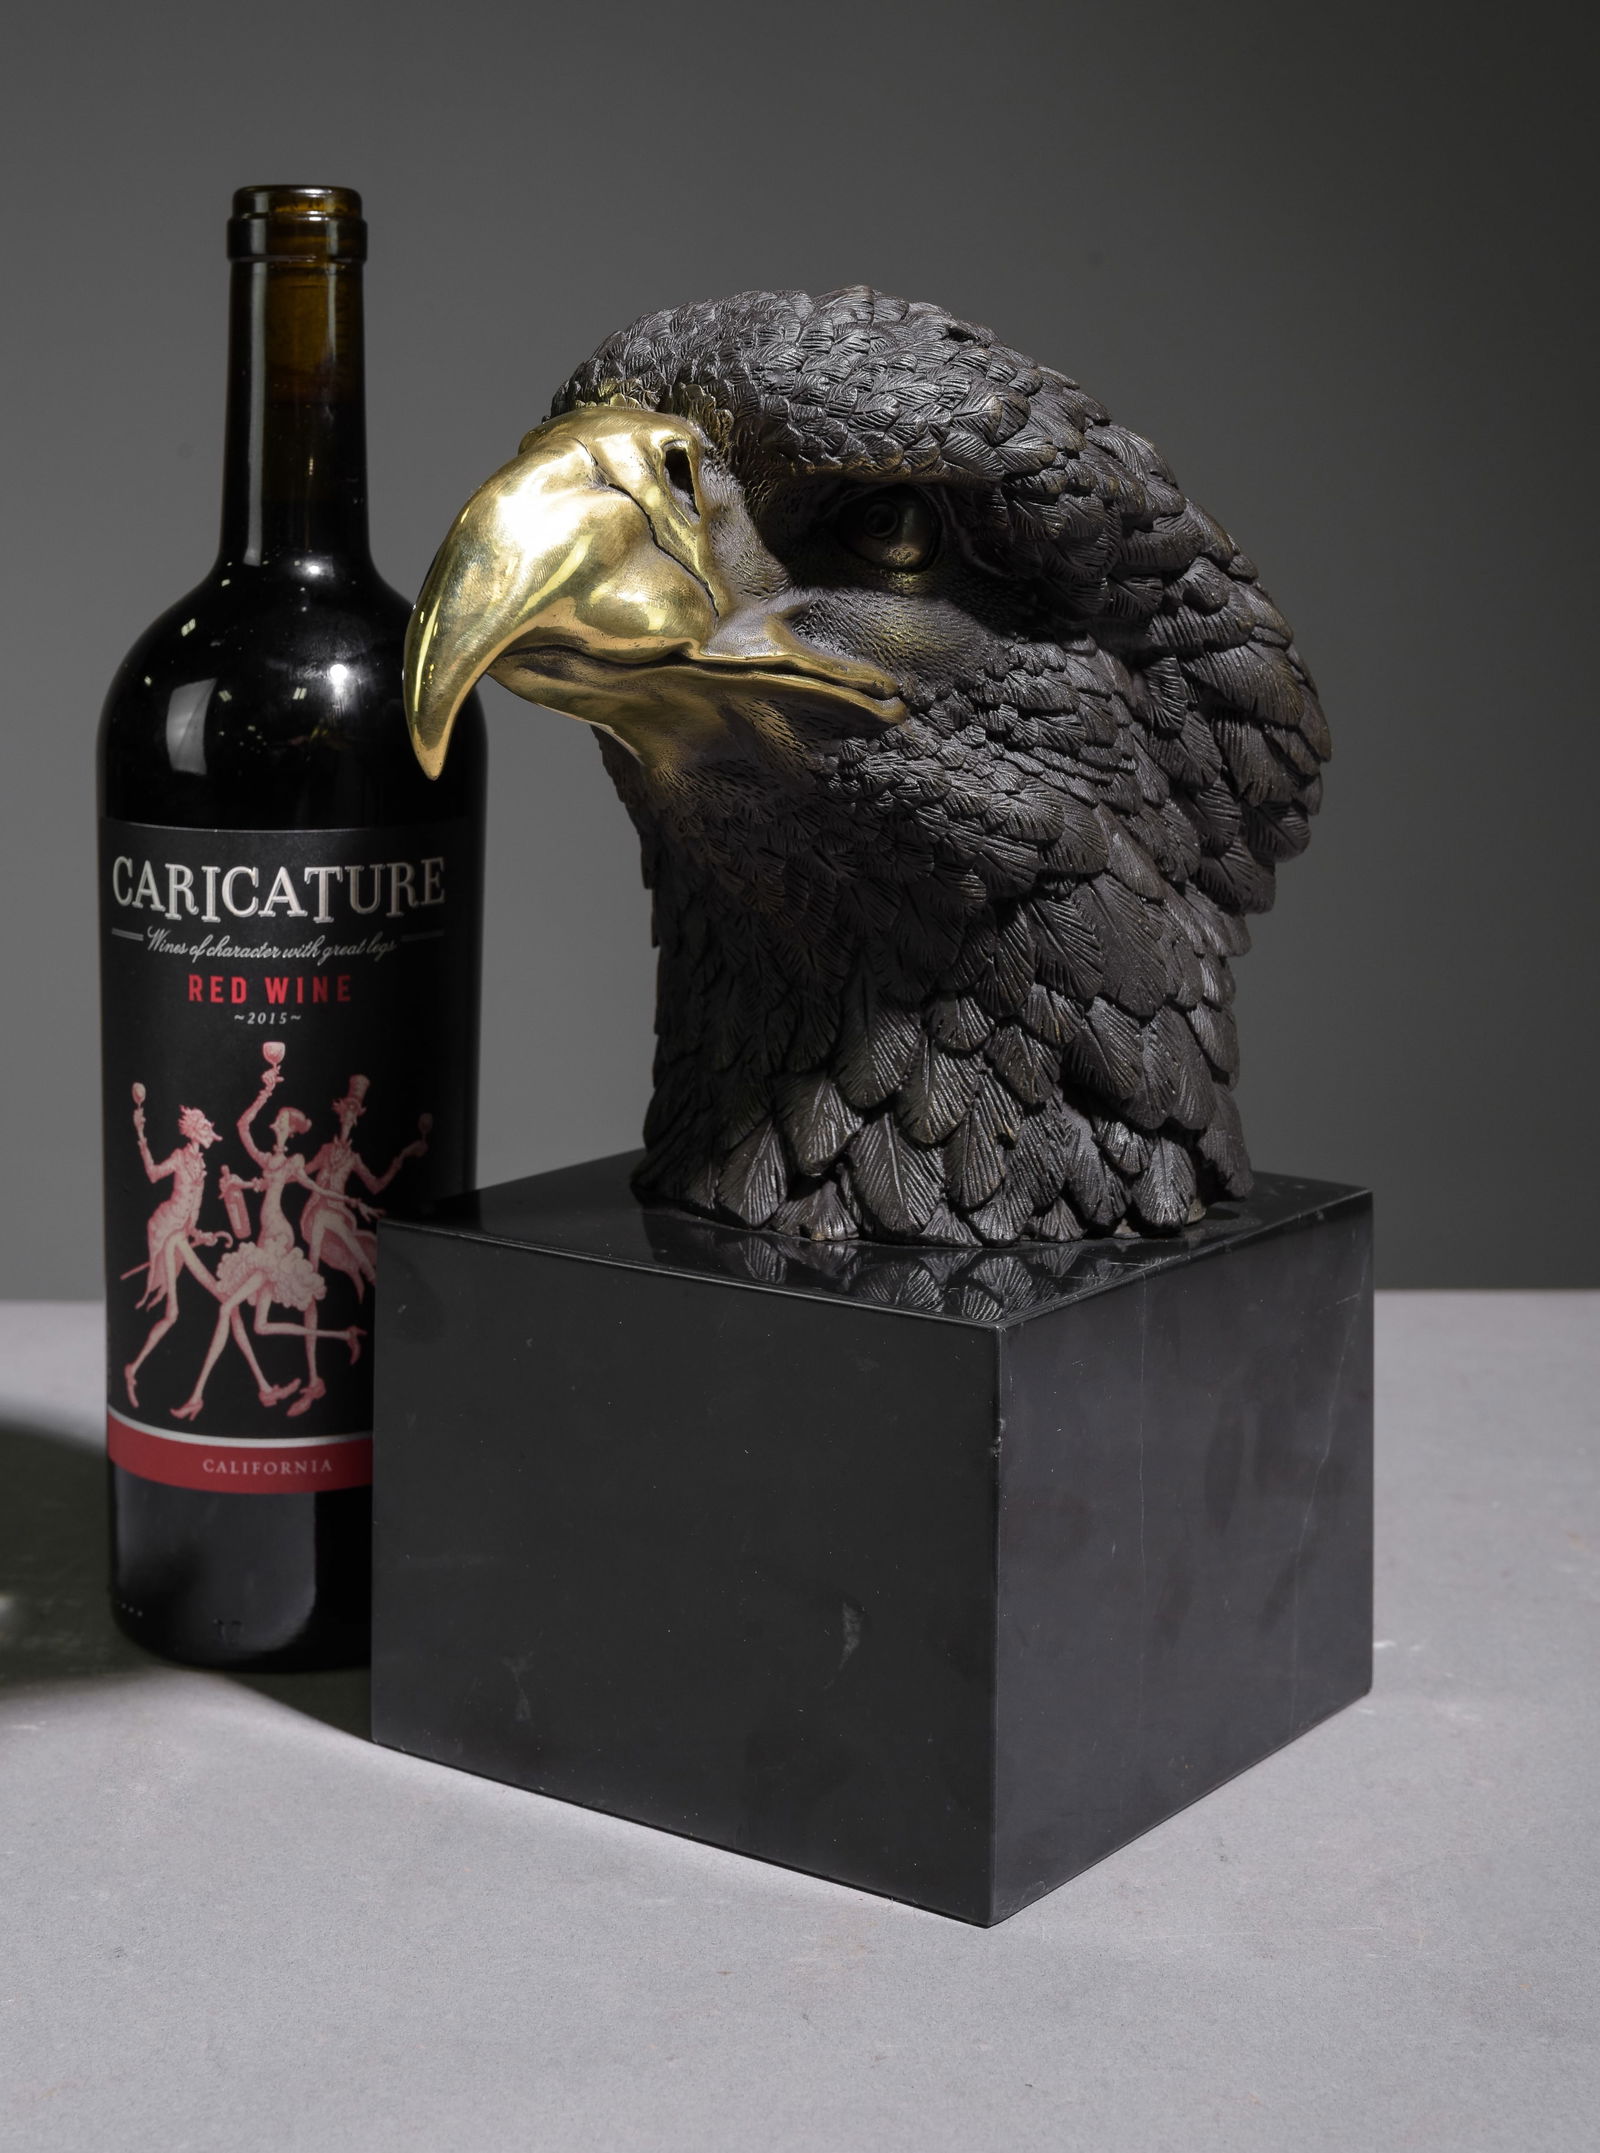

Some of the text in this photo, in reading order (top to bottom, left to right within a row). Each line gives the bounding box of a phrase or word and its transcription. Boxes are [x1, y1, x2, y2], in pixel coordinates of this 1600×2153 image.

[112, 855, 446, 924] CARICATURE
[147, 925, 398, 967] Wines of character with great legs
[187, 974, 352, 1005] RED WINE
[202, 1458, 333, 1475] CALIFORNIA
